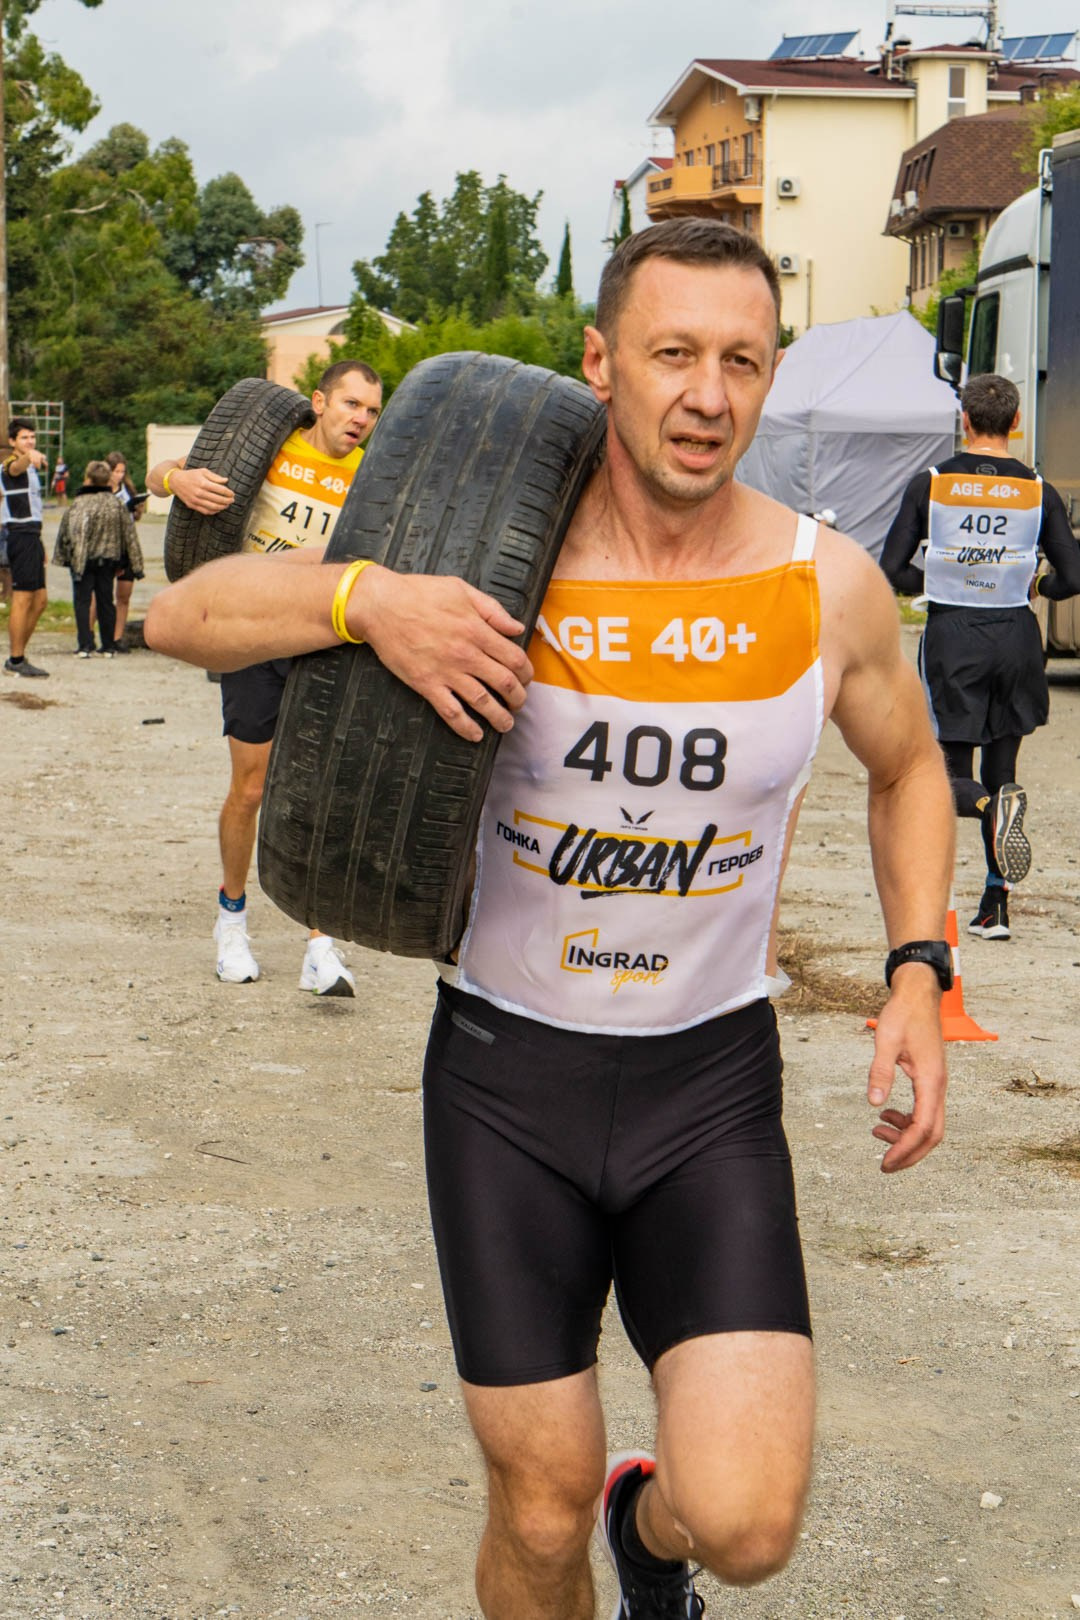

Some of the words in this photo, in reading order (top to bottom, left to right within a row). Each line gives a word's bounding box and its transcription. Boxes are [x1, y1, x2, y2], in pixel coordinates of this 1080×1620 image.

[278, 461, 315, 484] AGE
[950, 482, 984, 497] AGE
[988, 484, 1020, 498] 40+
[280, 501, 331, 535] 411
[959, 514, 1007, 535] 402
[957, 546, 1006, 566] URBAN
[965, 579, 996, 590] INGRAD
[651, 616, 757, 662] 40+
[563, 720, 728, 792] 408
[496, 820, 541, 855] ГОНКА
[549, 823, 719, 900] URBAN
[707, 844, 764, 876] ГЕРОЕВ
[568, 945, 669, 972] INGRAD
[610, 964, 667, 994] sport
